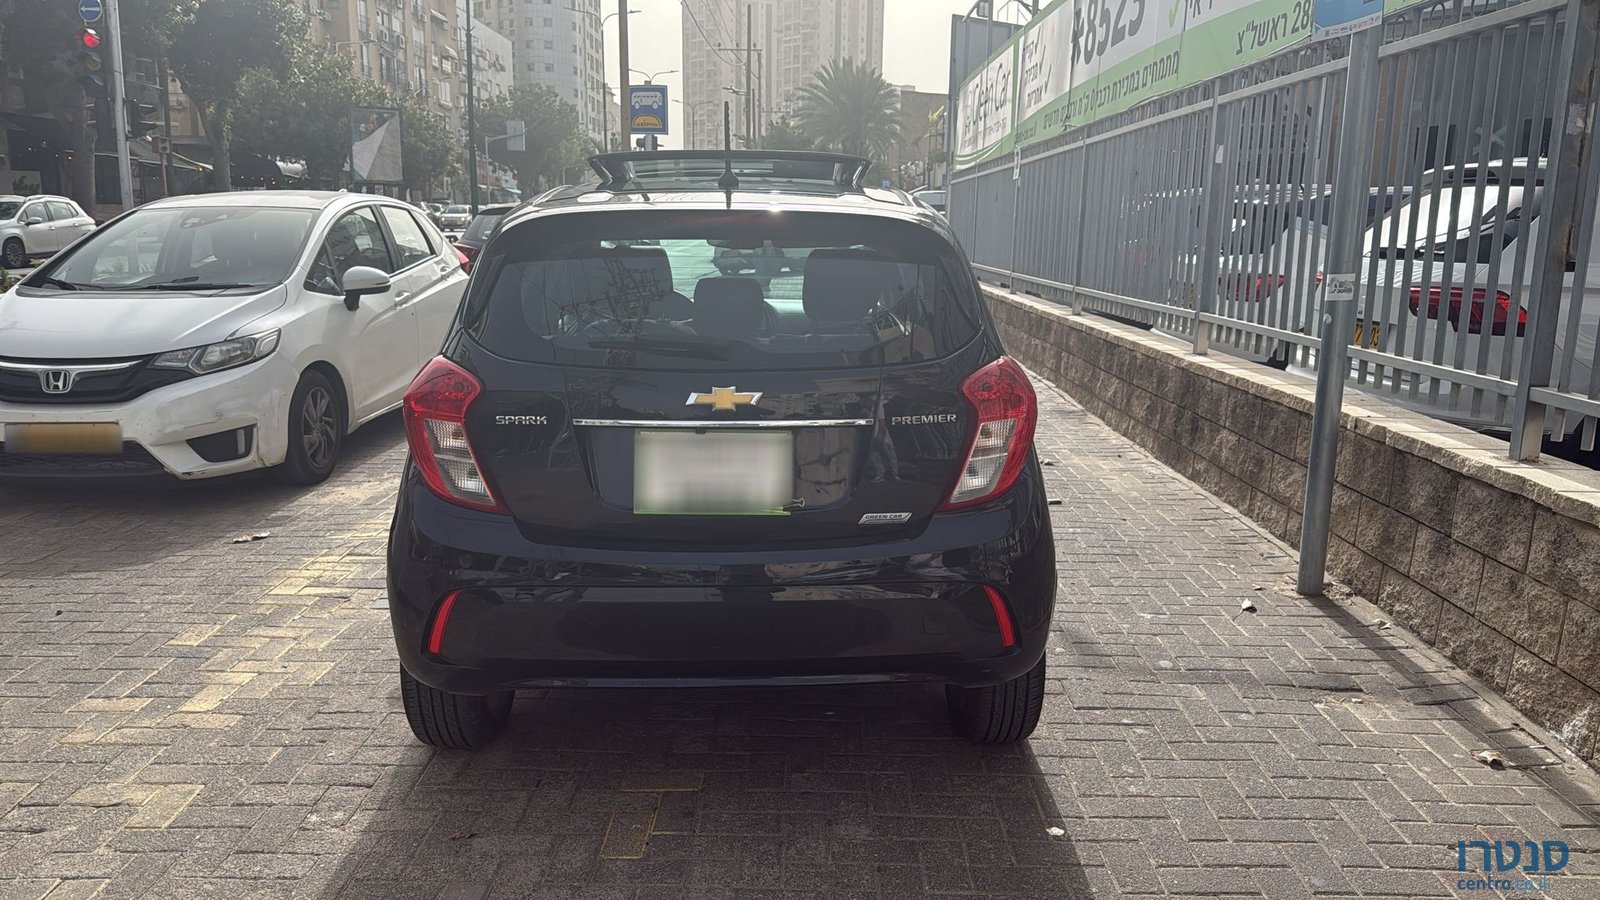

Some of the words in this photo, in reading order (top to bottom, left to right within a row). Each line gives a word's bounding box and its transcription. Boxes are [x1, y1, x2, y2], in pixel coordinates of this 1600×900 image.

[1236, 12, 1287, 55] ראשל"צ
[1291, 0, 1310, 34] 28
[1111, 69, 1140, 102] במכירת
[1142, 50, 1180, 88] מתמחים
[495, 415, 547, 425] SPARK
[891, 413, 957, 425] PREMIER
